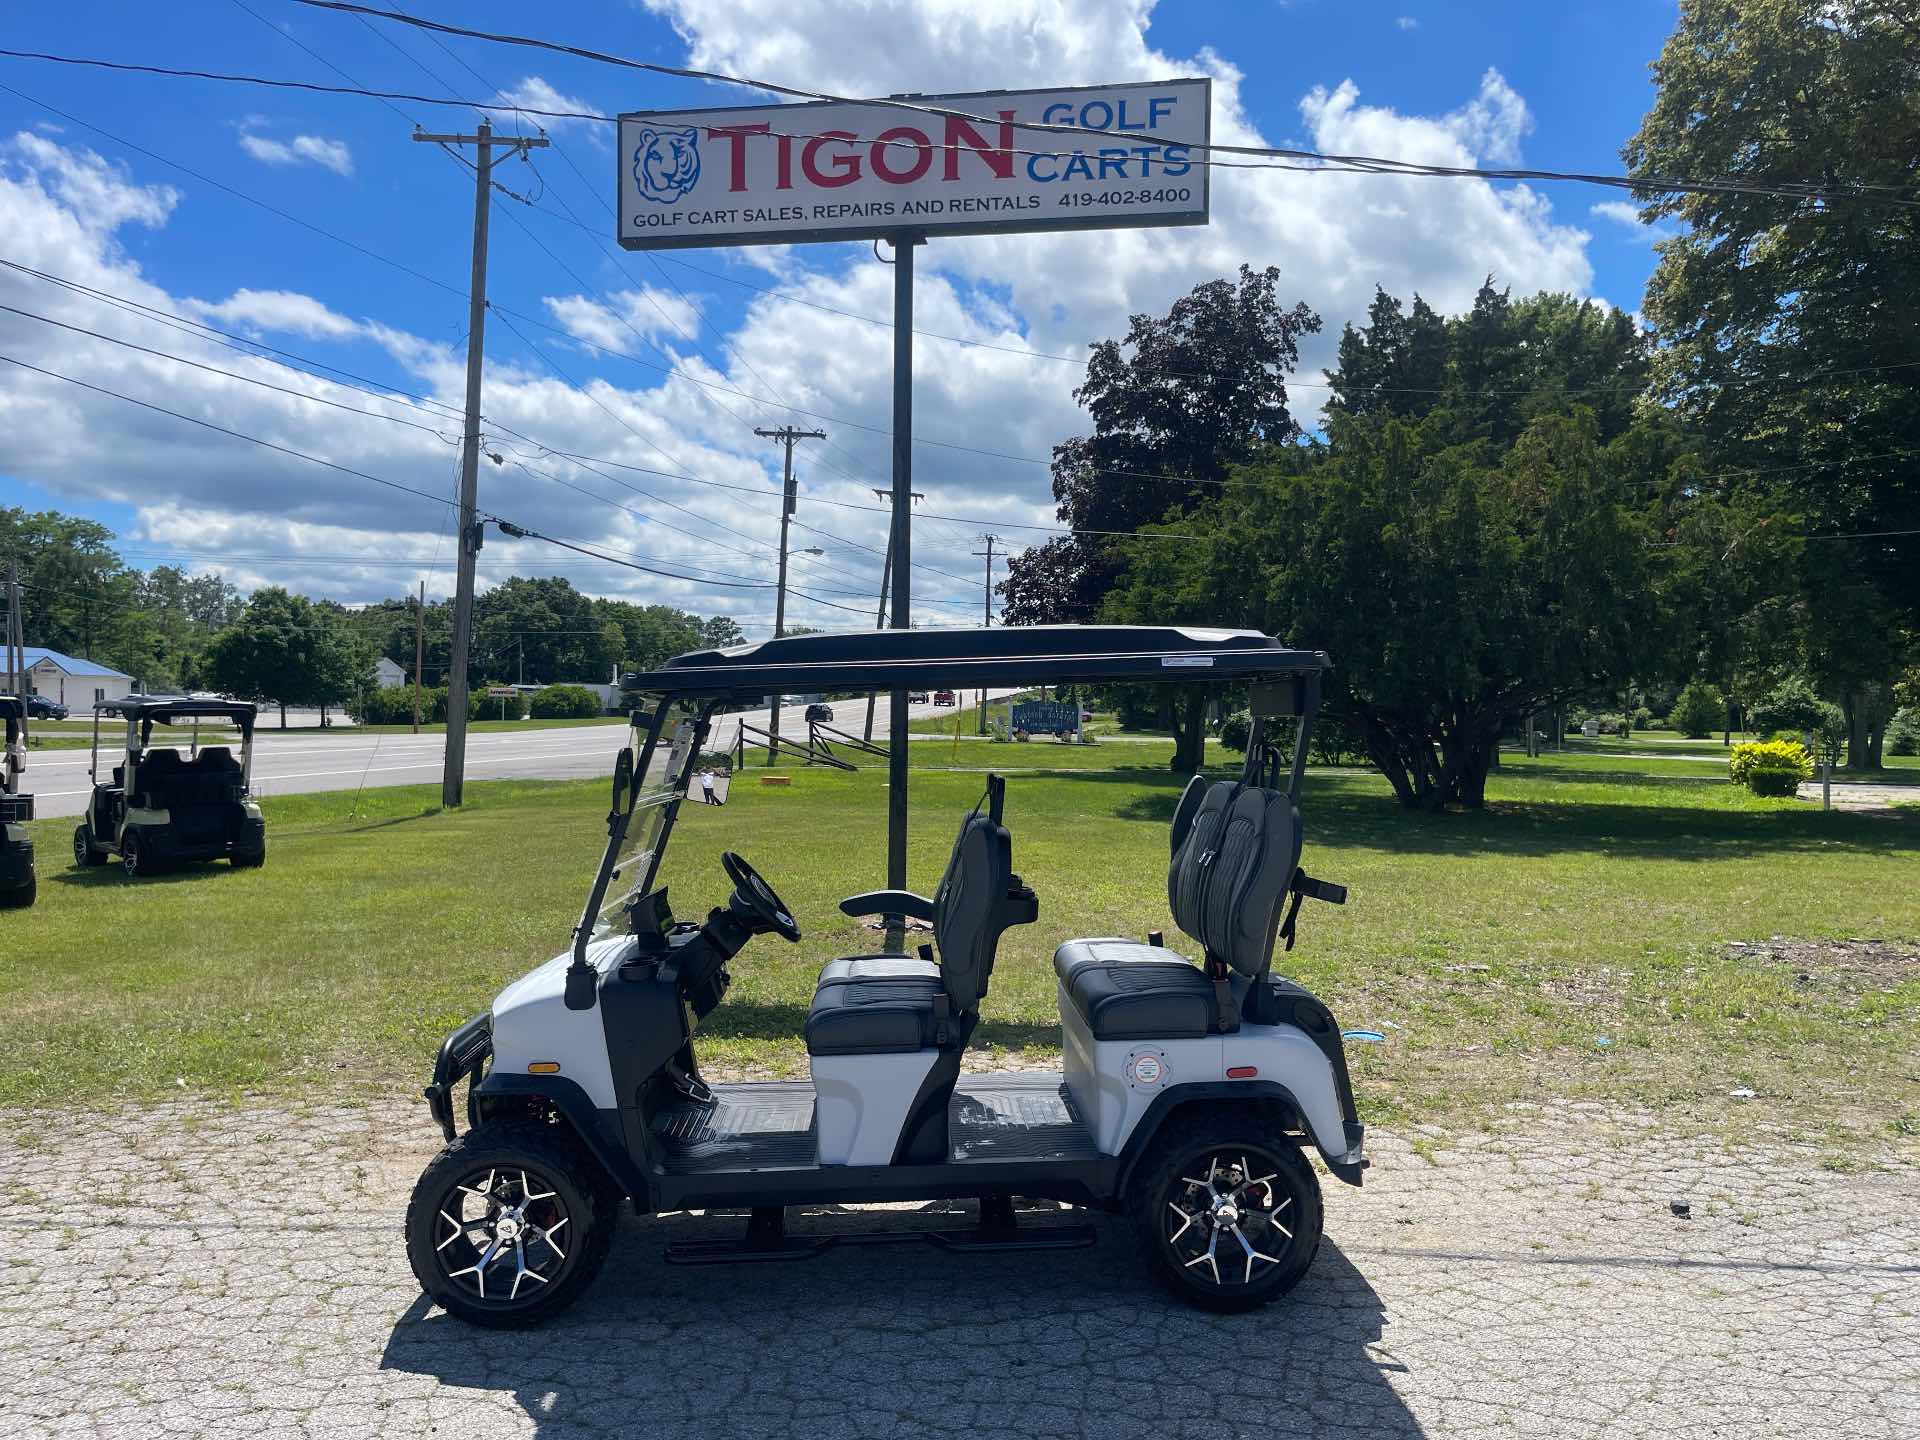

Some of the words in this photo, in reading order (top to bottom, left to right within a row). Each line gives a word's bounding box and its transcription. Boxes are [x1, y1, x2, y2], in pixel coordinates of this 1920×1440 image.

[1042, 96, 1177, 131] GOLF
[708, 110, 1017, 193] TIGON
[1027, 146, 1192, 183] CARTS
[633, 212, 682, 228] GOLF
[687, 210, 738, 225] CART
[743, 206, 808, 222] SALES,
[813, 201, 895, 219] REPAIRS
[901, 199, 944, 215] AND
[950, 195, 1041, 213] RENTALS
[1058, 188, 1191, 208] 419-402-8400
